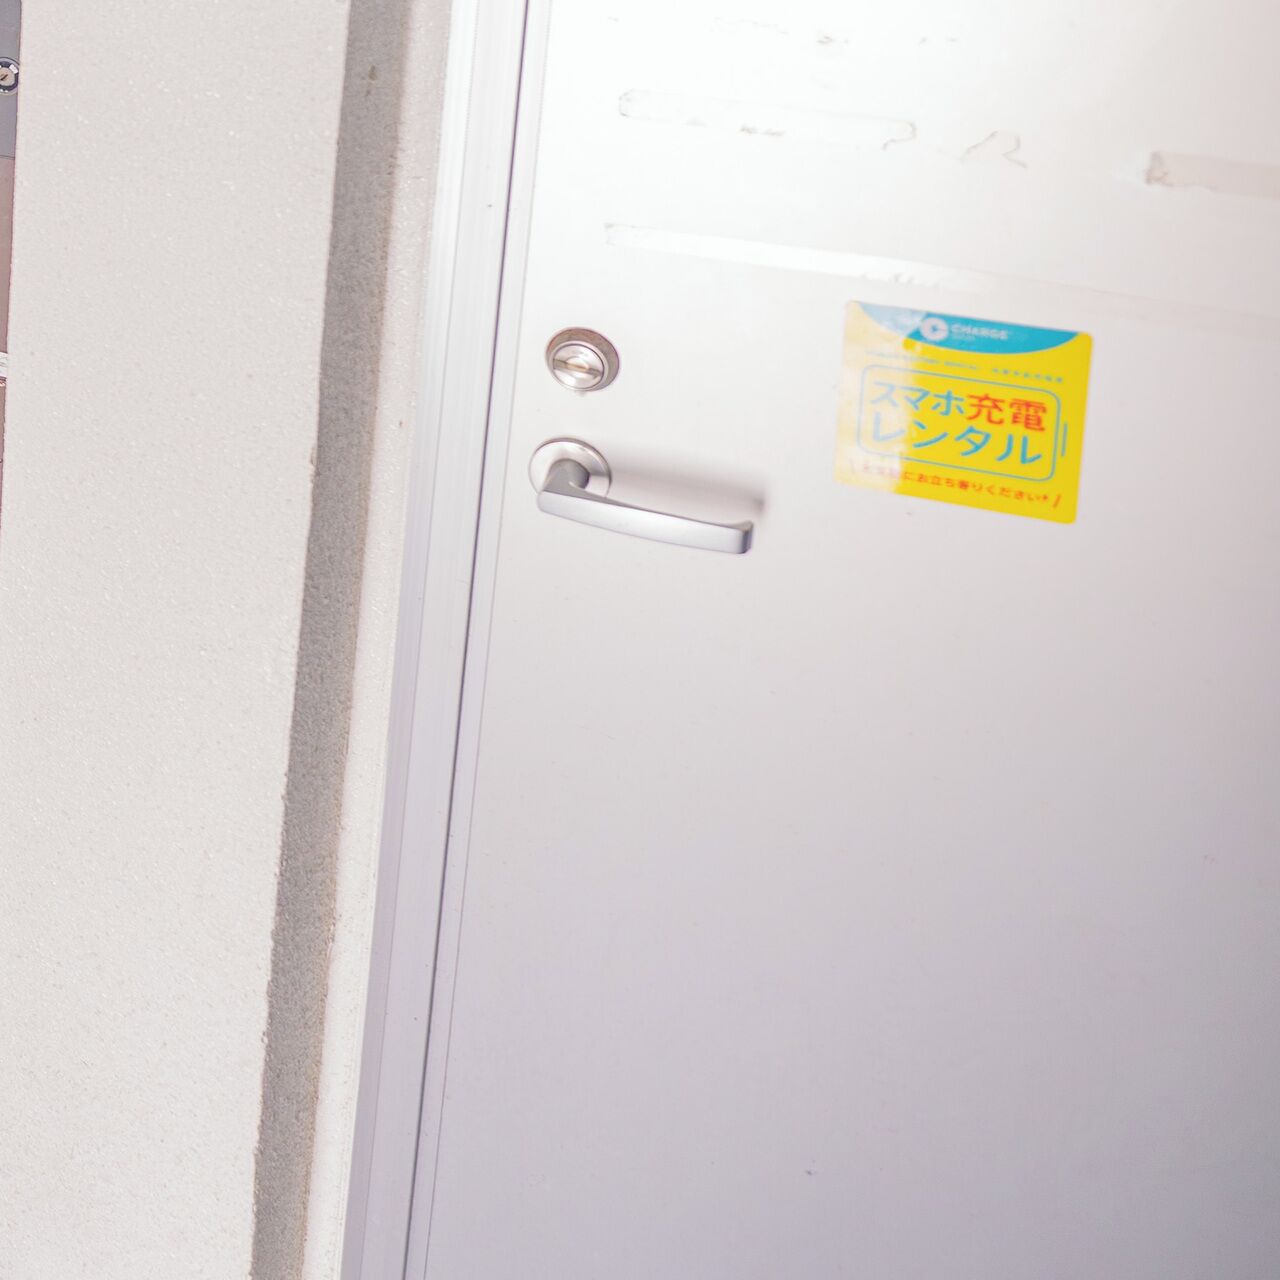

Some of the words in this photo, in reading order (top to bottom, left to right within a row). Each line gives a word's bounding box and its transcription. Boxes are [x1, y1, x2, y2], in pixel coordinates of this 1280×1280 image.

[870, 381, 1047, 432] スマホ充電
[871, 411, 1043, 465] レンタル
